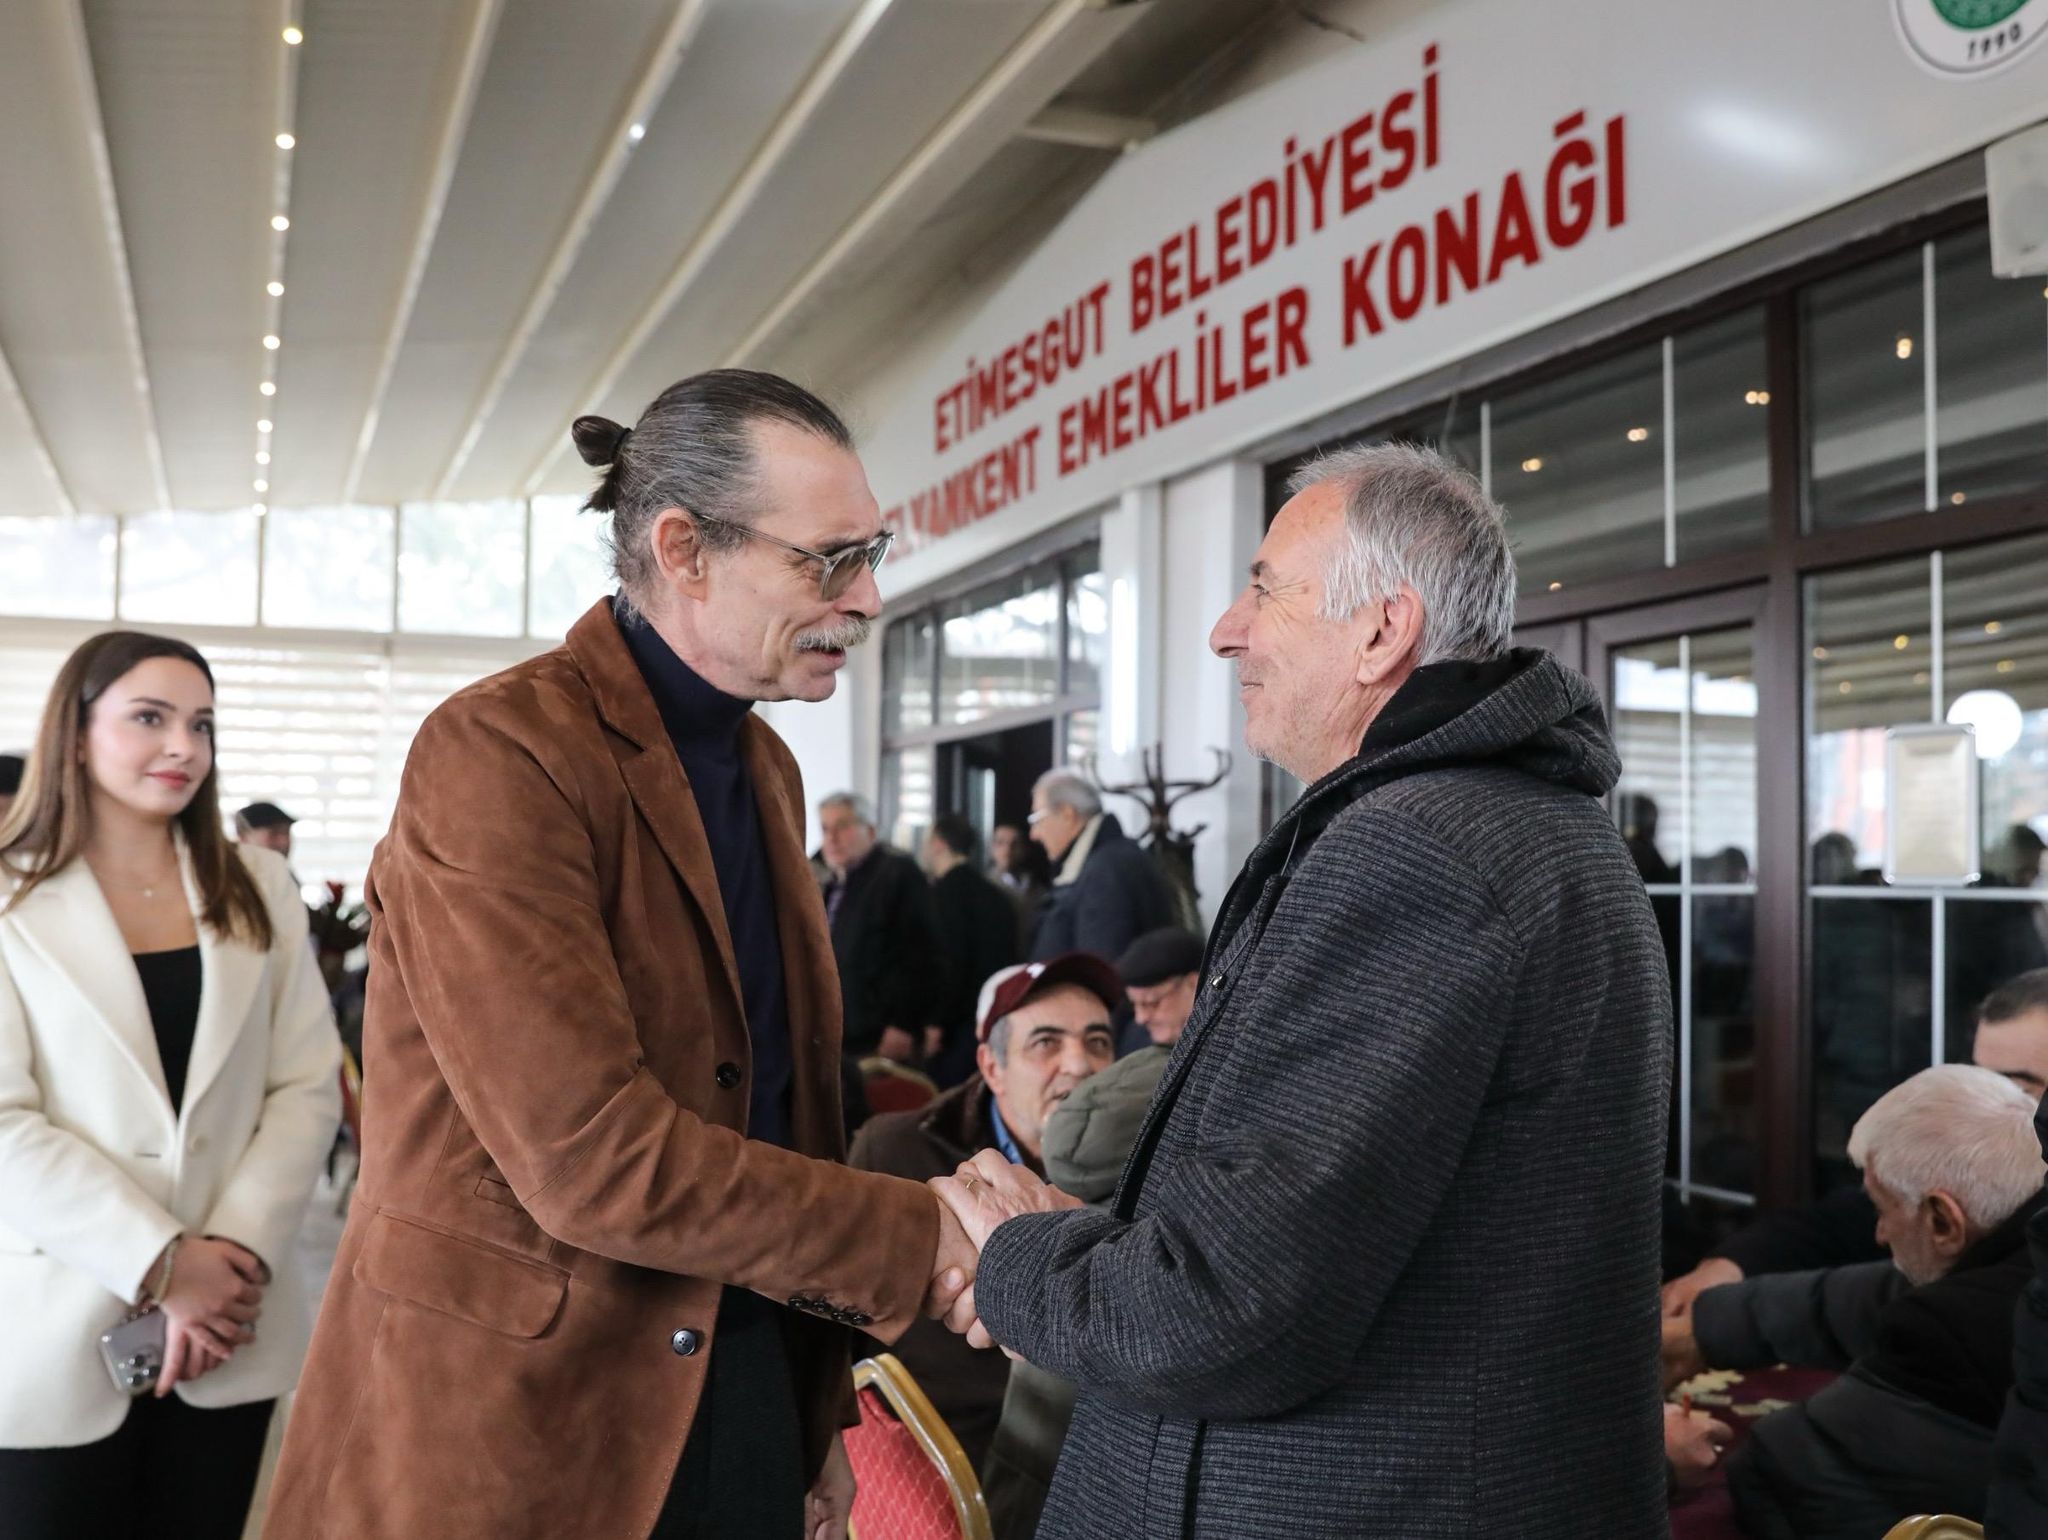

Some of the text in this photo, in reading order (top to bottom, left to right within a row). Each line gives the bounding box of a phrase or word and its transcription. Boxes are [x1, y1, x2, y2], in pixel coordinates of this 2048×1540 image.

[934, 42, 1440, 454] ETİMESGUT BELEDİYESİ
[1057, 284, 1310, 477] EMEKLİLER
[1340, 109, 1628, 348] KONAĞI
